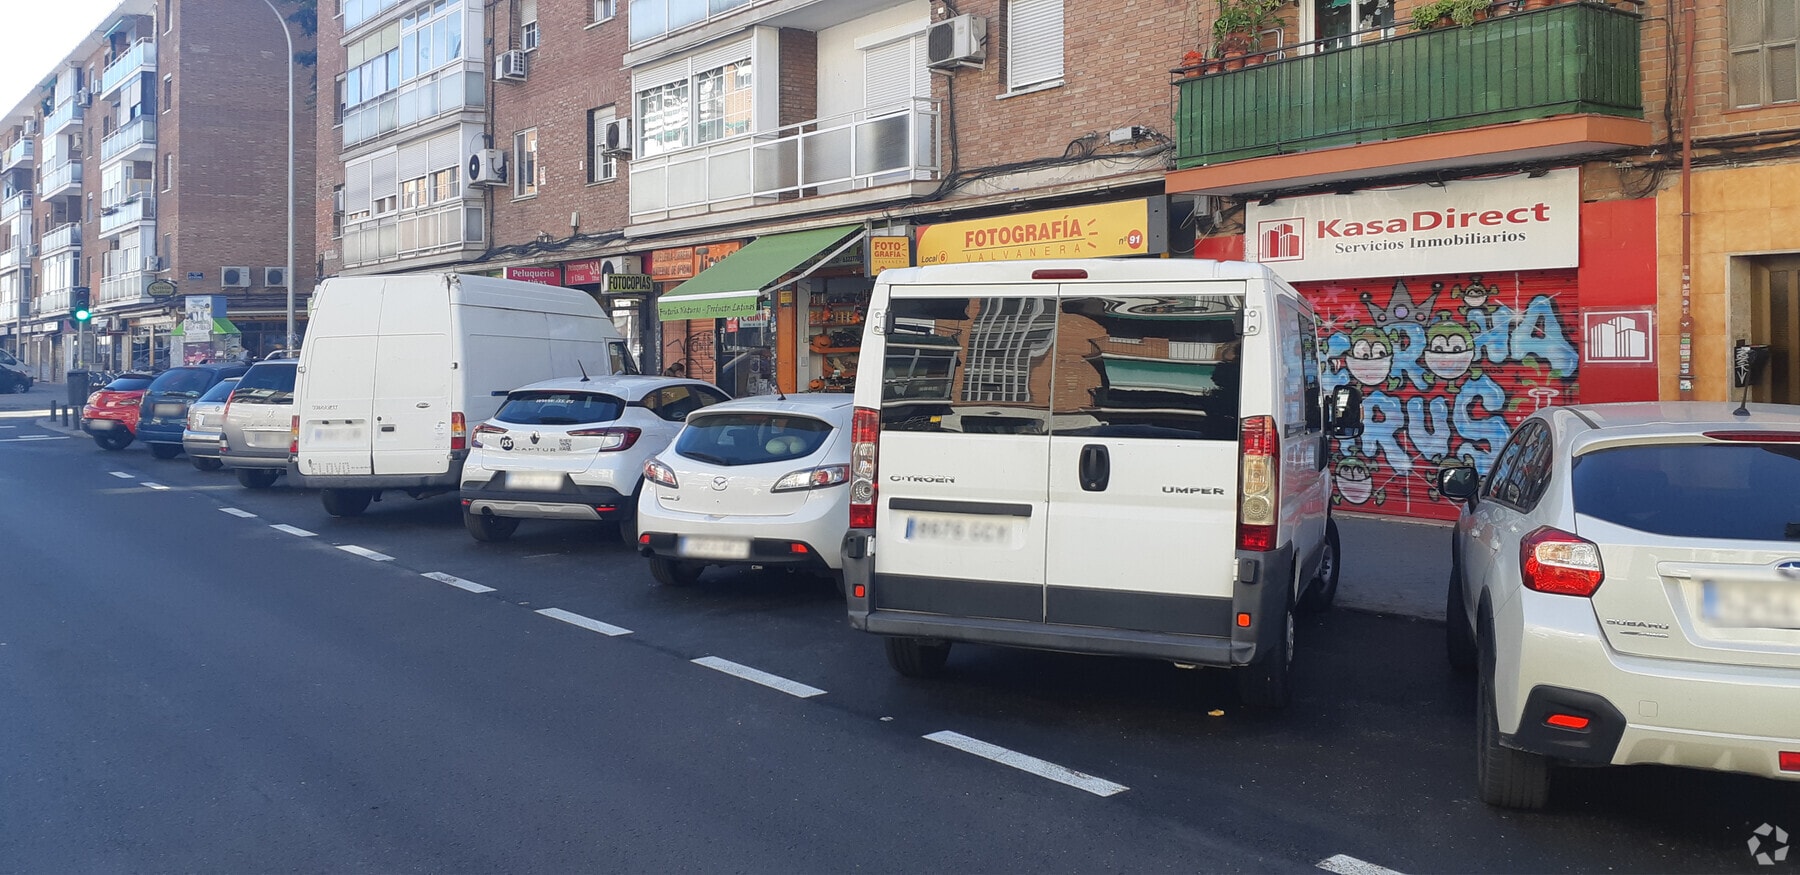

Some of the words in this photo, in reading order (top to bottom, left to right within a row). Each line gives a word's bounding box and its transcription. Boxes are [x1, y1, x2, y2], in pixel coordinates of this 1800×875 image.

[1317, 202, 1551, 239] KasaDirect
[965, 215, 1083, 248] FOTOGRAFÍA
[874, 241, 901, 251] FOTO
[1129, 234, 1141, 245] 91
[1335, 237, 1405, 254] Servicios
[1410, 230, 1527, 249] Inmobiliarios
[921, 254, 938, 263] Local
[940, 252, 946, 262] 6
[966, 242, 1081, 263] VALVANERA
[609, 275, 652, 290] FOTOCOPIAS
[1162, 485, 1225, 496] UMPER
[1606, 618, 1669, 630] SUBARU
